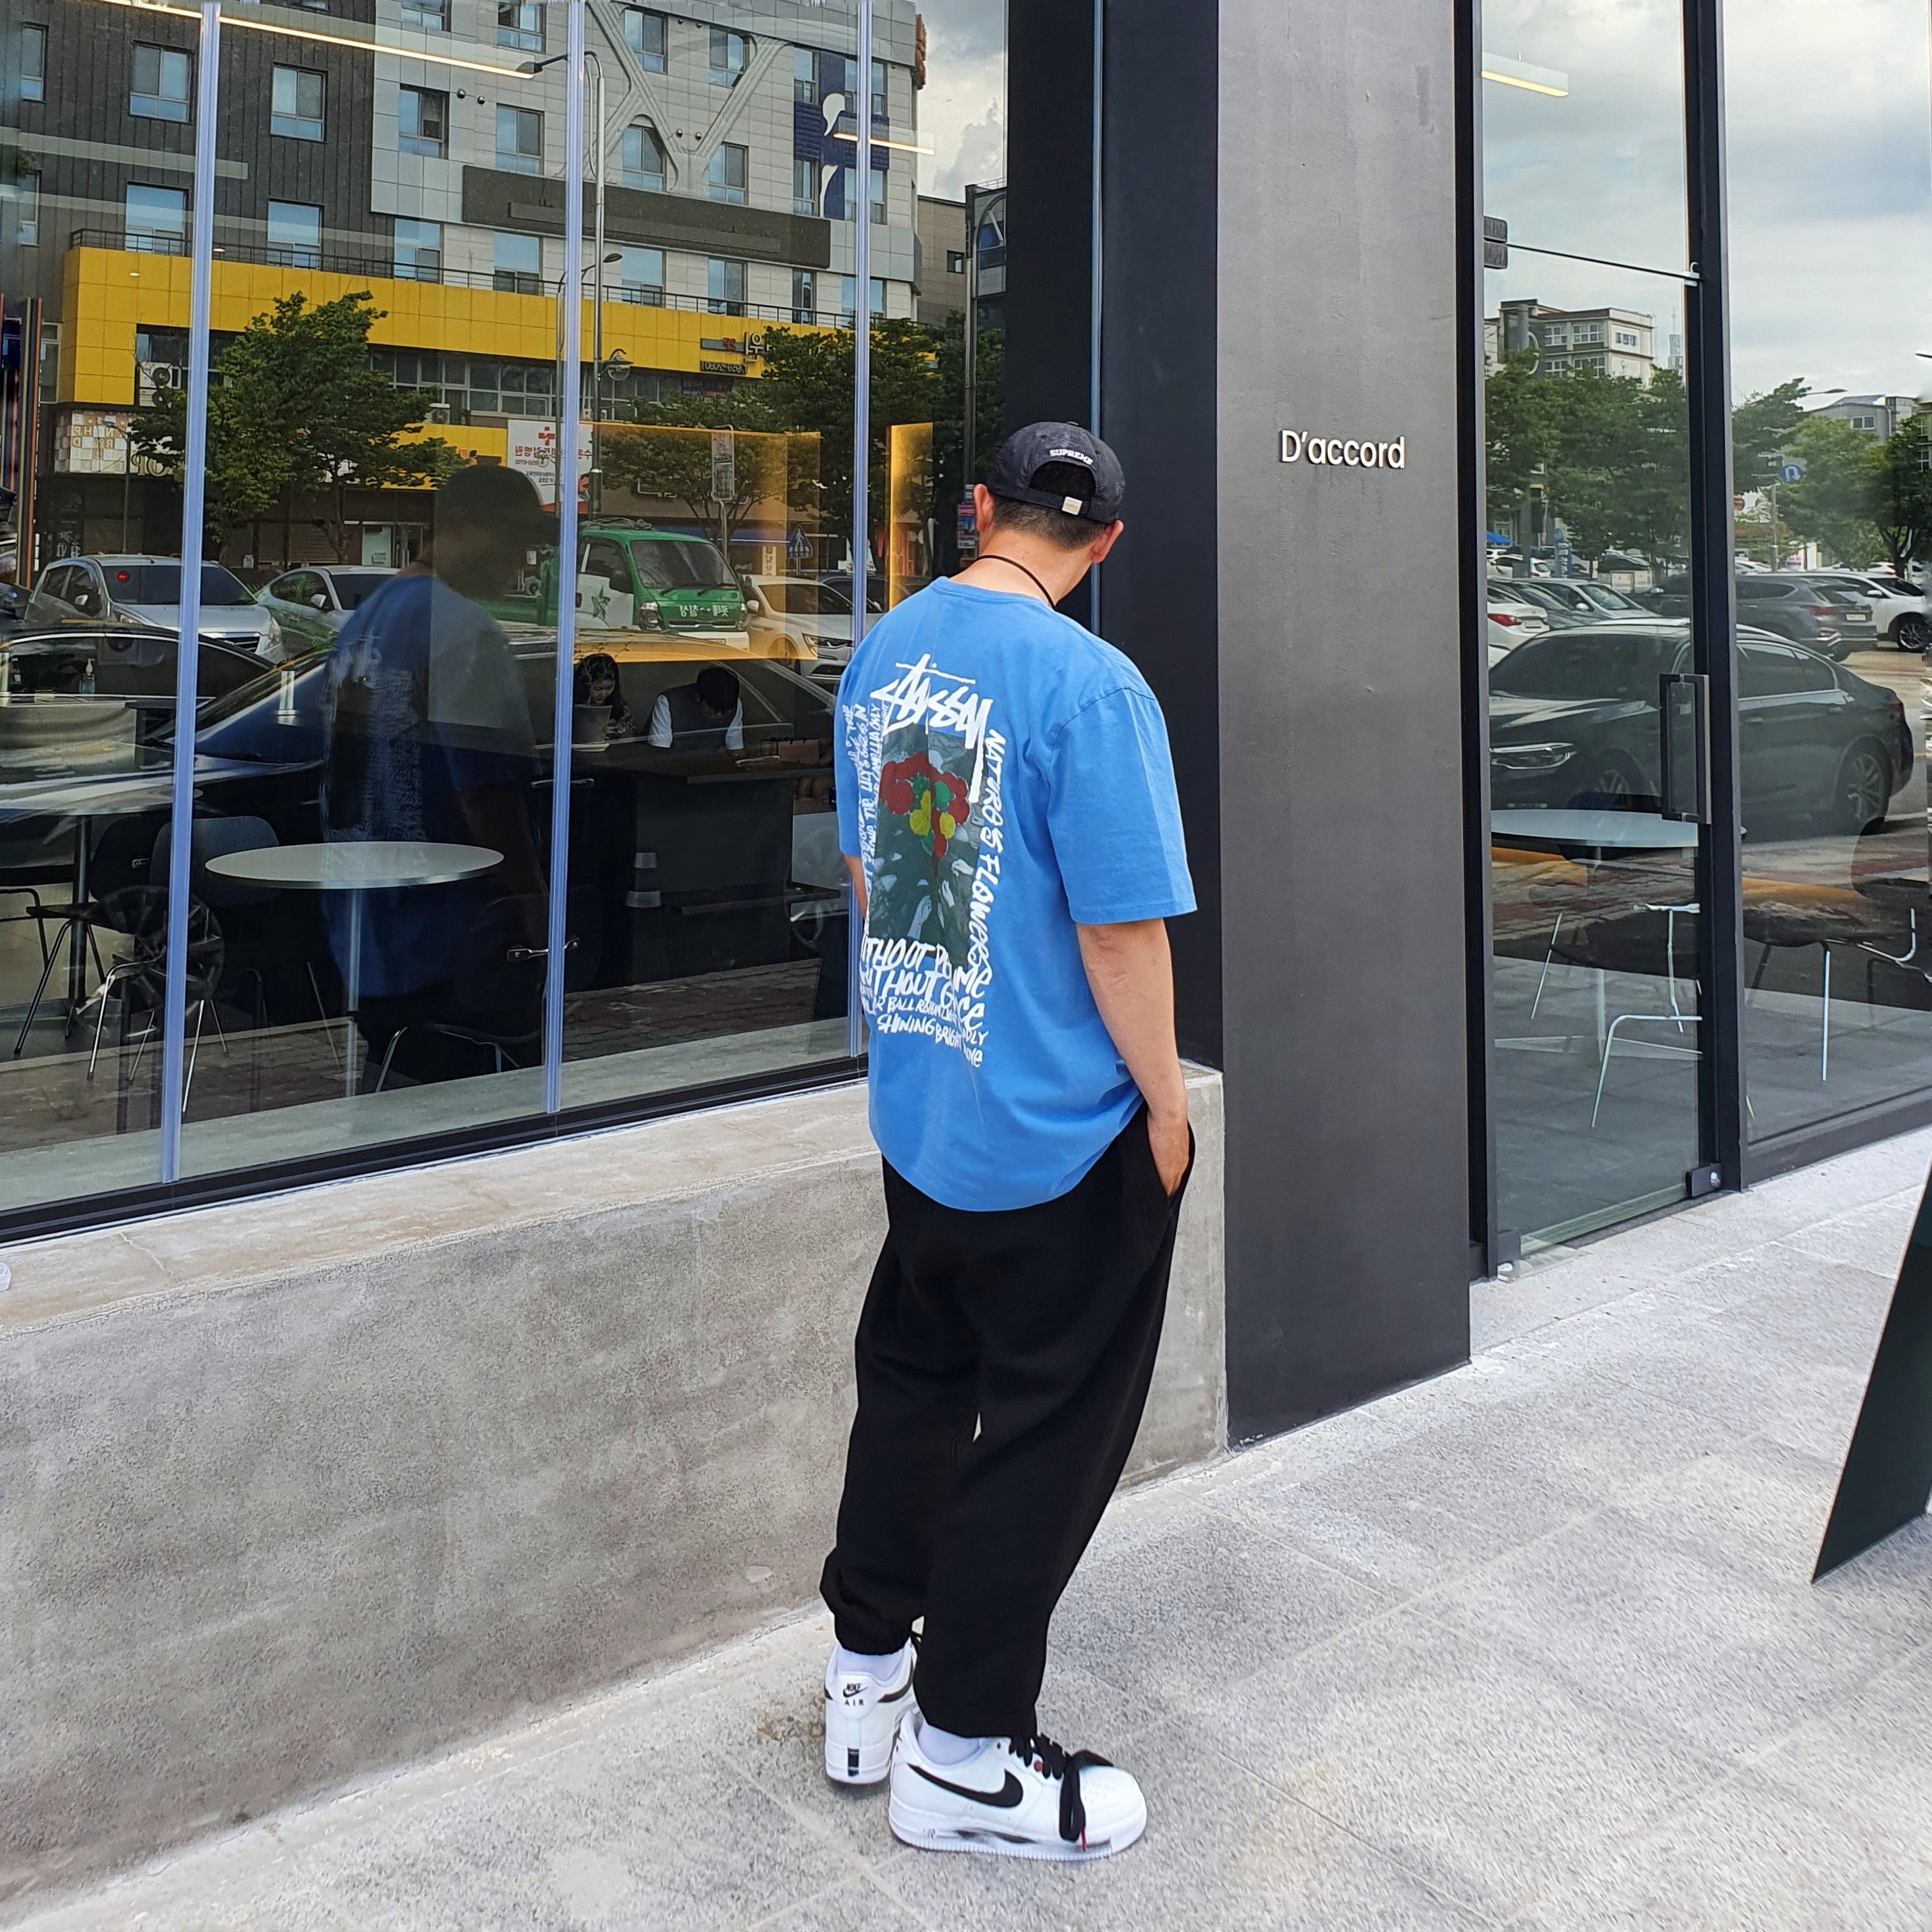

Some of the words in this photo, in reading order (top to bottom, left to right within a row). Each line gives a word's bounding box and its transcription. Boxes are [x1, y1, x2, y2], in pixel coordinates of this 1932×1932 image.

[1281, 429, 1405, 469] D'accord
[1049, 448, 1094, 466] SUPREME
[845, 1683, 862, 1693] NIKE
[844, 1698, 864, 1707] AIR
